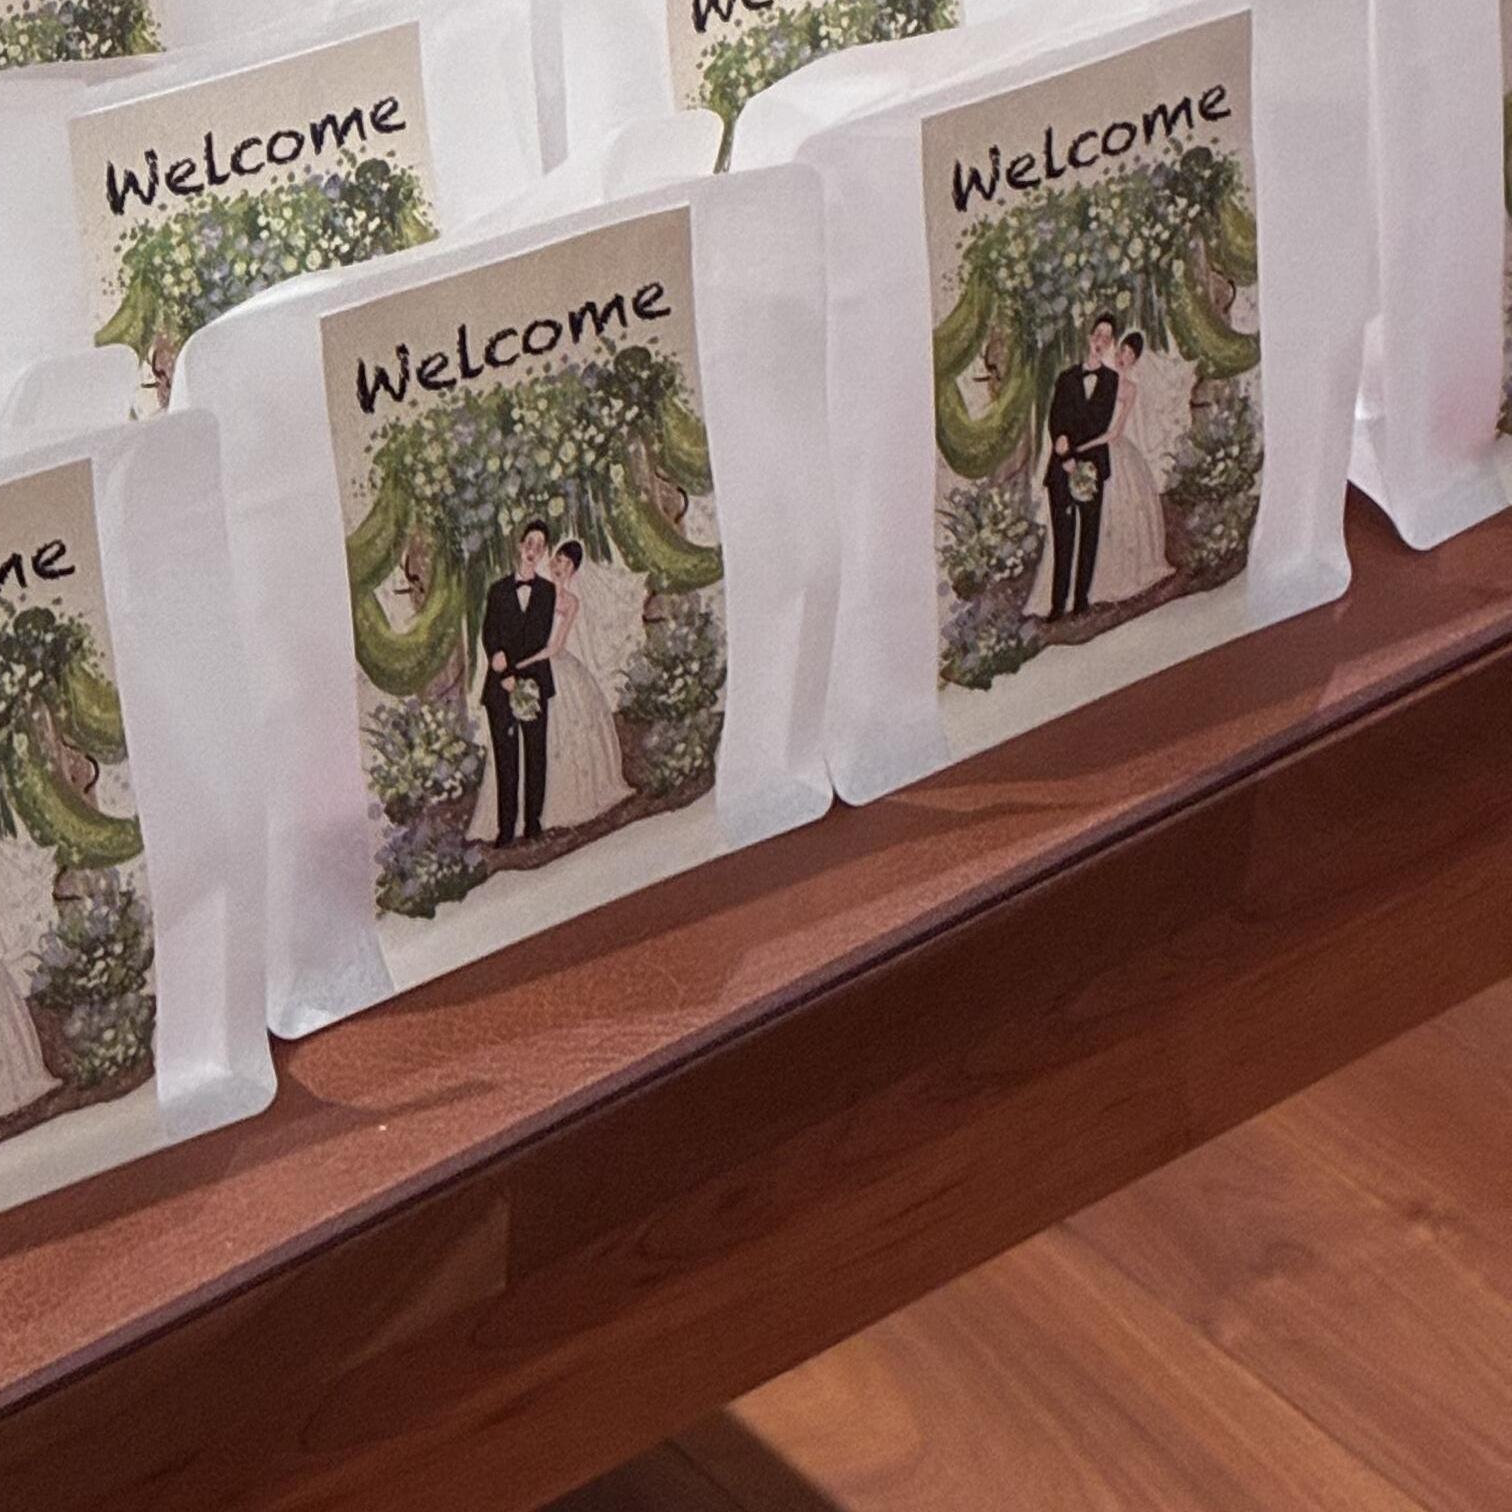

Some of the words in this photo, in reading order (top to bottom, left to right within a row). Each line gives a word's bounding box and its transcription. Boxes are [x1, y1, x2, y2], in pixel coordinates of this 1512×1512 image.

[106, 94, 406, 216] Welcome
[952, 83, 1232, 216] Welcome
[357, 281, 672, 415] Welcome
